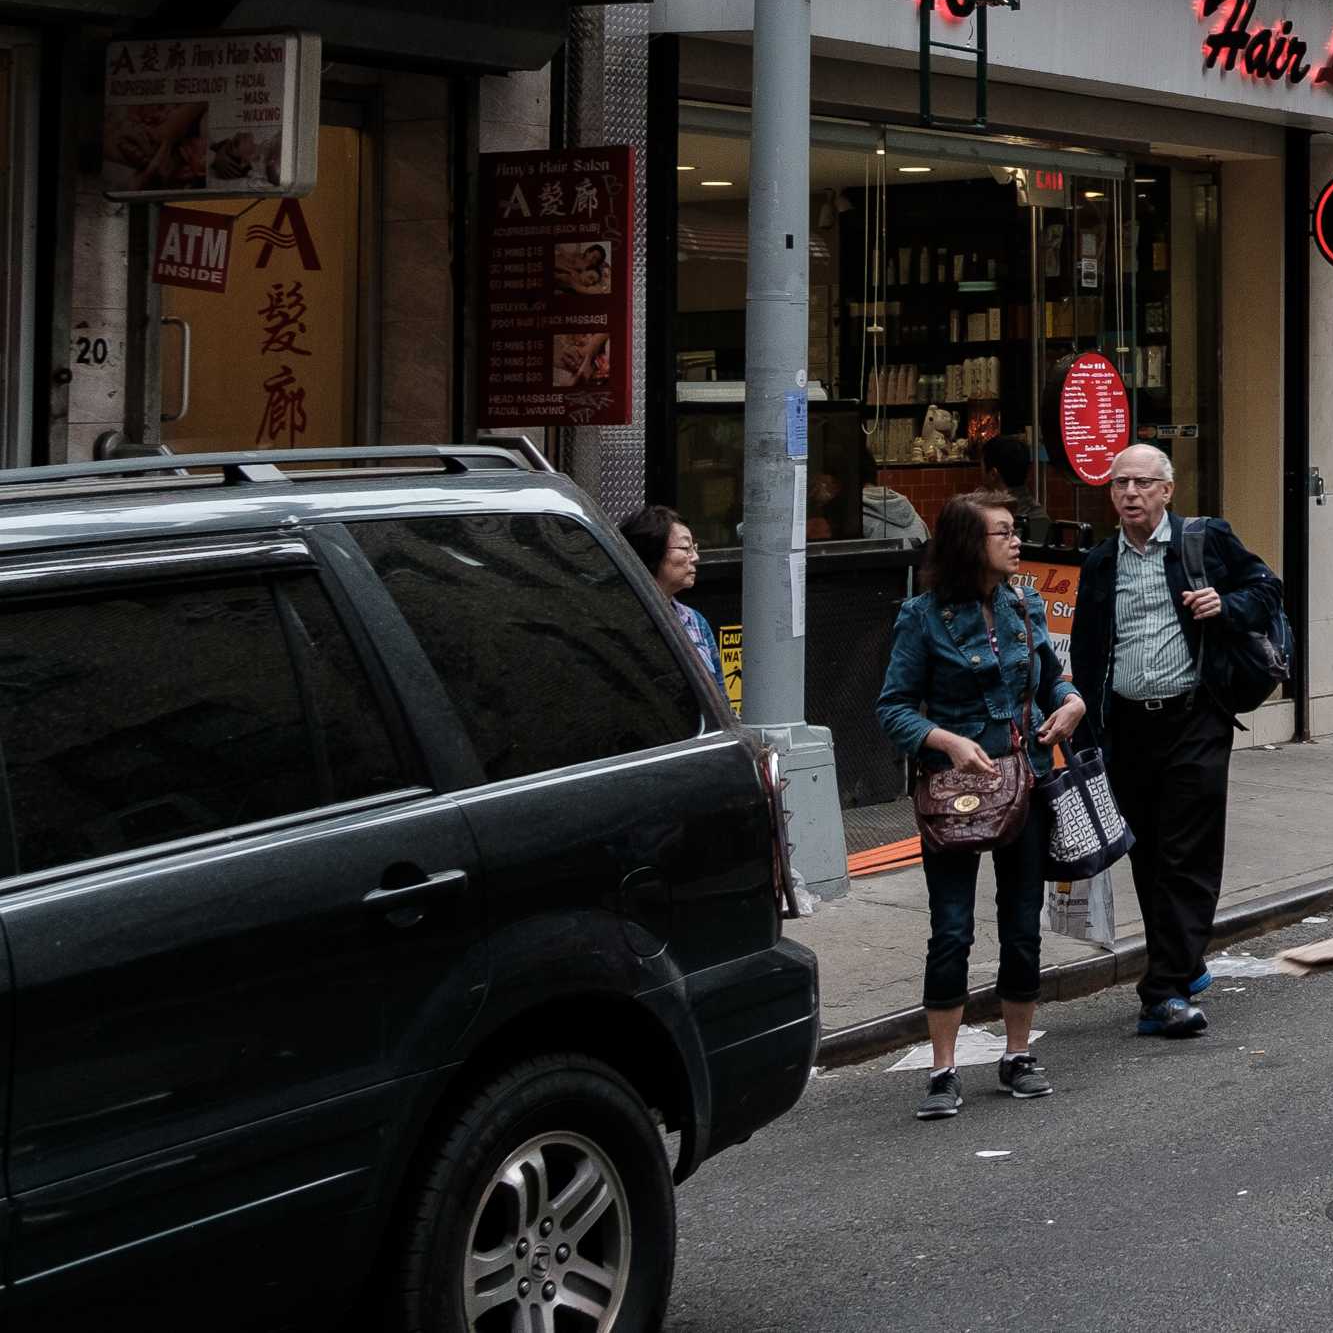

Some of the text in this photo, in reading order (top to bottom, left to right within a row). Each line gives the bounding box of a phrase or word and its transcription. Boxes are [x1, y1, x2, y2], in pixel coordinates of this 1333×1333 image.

[112, 45, 134, 75] A
[254, 42, 283, 64] Salon
[235, 73, 266, 89] FACIAL
[539, 161, 568, 175] Hair
[572, 158, 611, 172] Salon
[498, 182, 532, 218] A
[160, 222, 228, 269] ATM
[158, 263, 223, 284] INSIDE
[76, 336, 108, 364] 20
[517, 393, 564, 404] MASSAGE
[1040, 569, 1071, 594] Le
[1052, 602, 1075, 618] Str
